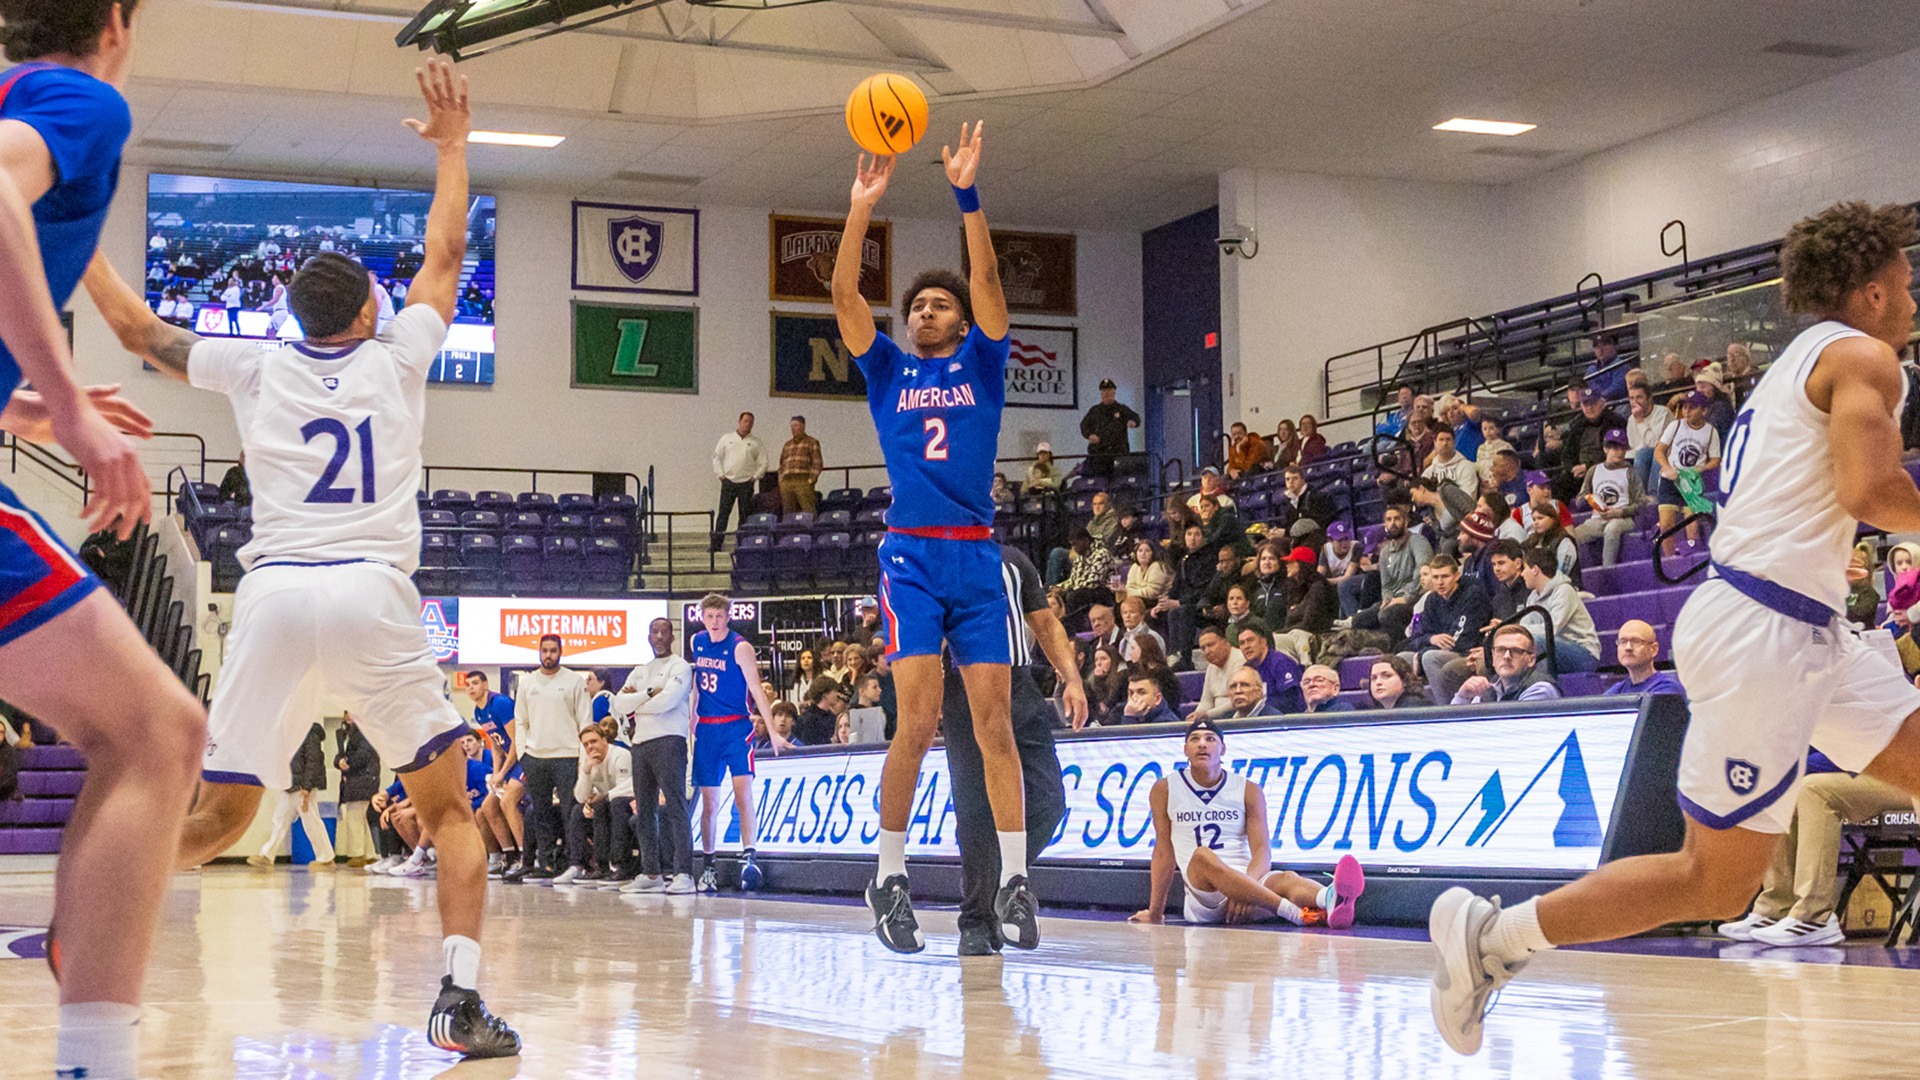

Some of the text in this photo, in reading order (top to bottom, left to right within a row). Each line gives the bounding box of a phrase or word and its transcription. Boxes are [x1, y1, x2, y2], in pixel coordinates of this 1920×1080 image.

[612, 319, 659, 376] L
[808, 337, 848, 382] N
[455, 363, 463, 379] 2
[1004, 367, 1066, 382] TRIOT
[1006, 381, 1066, 395] AGUE
[923, 417, 949, 461] 2
[299, 415, 375, 503] 21
[505, 614, 622, 638] MASTERMAN'S
[701, 671, 718, 693] 33
[756, 773, 865, 845] MASIS
[1082, 750, 1453, 853] SOTIONS
[1176, 810, 1240, 823] HOLY CROSS
[1884, 813, 1918, 825] CRUSA
[1193, 823, 1225, 850] 12
